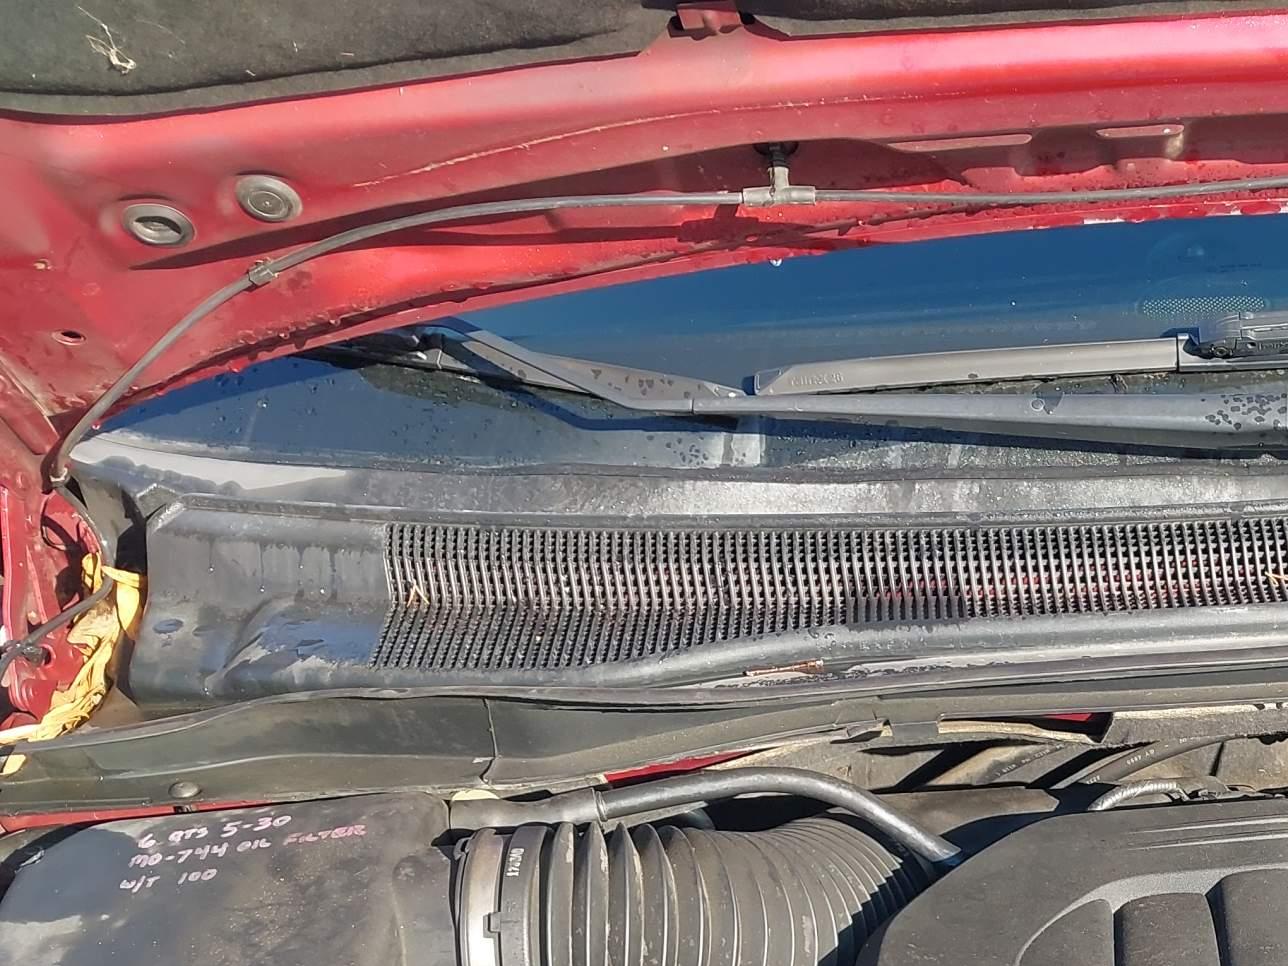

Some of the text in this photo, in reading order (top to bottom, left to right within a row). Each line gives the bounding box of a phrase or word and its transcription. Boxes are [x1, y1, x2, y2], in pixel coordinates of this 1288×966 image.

[138, 833, 156, 848] 6
[222, 815, 292, 837] 5-30
[283, 824, 367, 846] FILTER
[177, 868, 217, 885] 100
